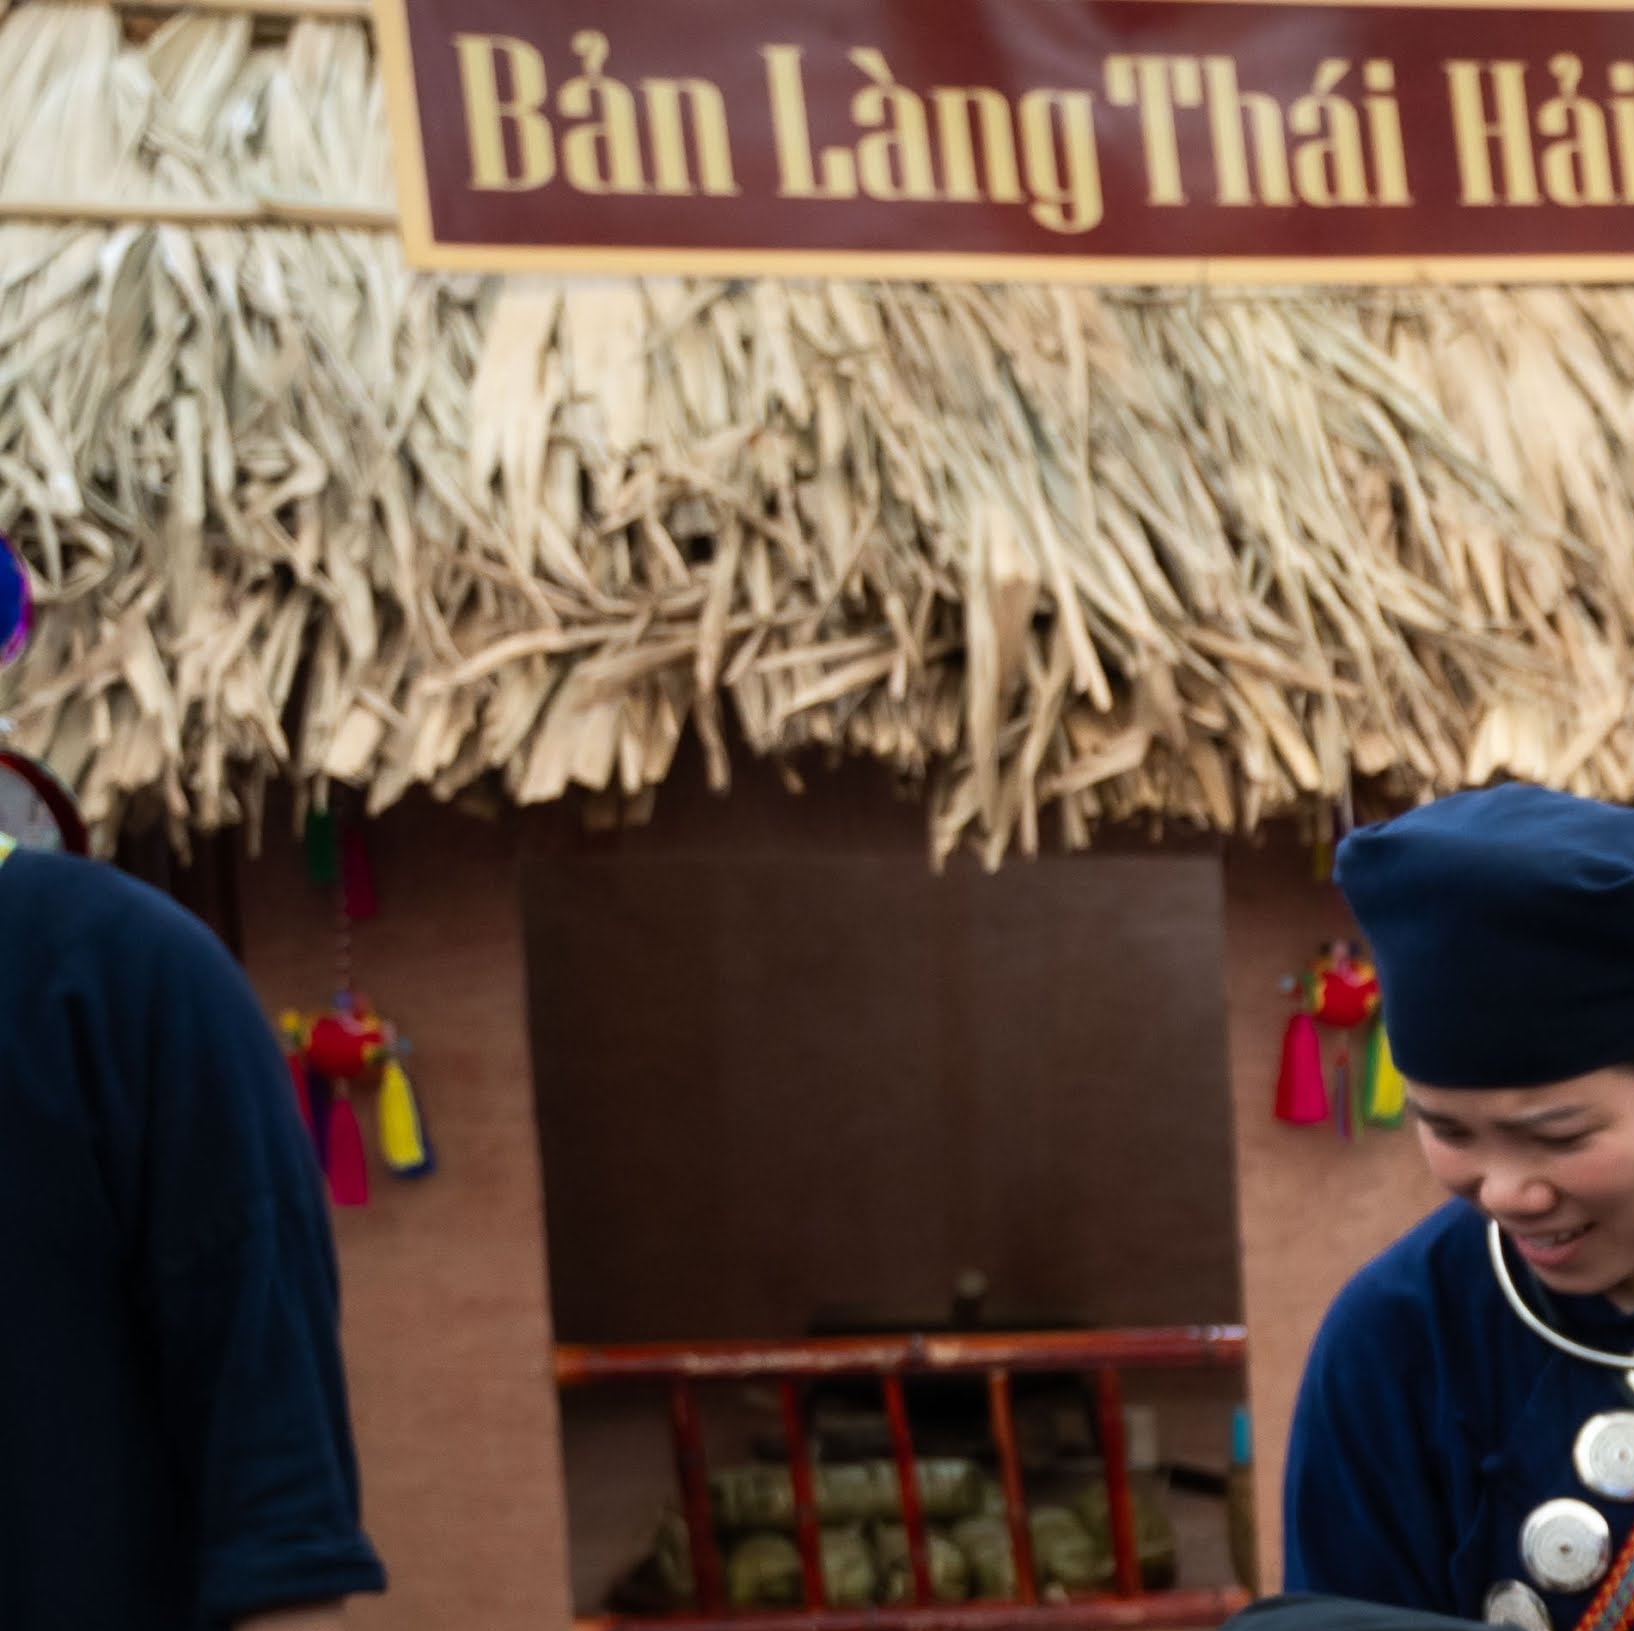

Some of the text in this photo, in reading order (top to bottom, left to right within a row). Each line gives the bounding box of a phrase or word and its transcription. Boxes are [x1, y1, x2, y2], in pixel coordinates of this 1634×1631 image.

[452, 30, 738, 198] Bản
[760, 42, 1105, 234] Làng
[1106, 52, 1414, 208] Thái
